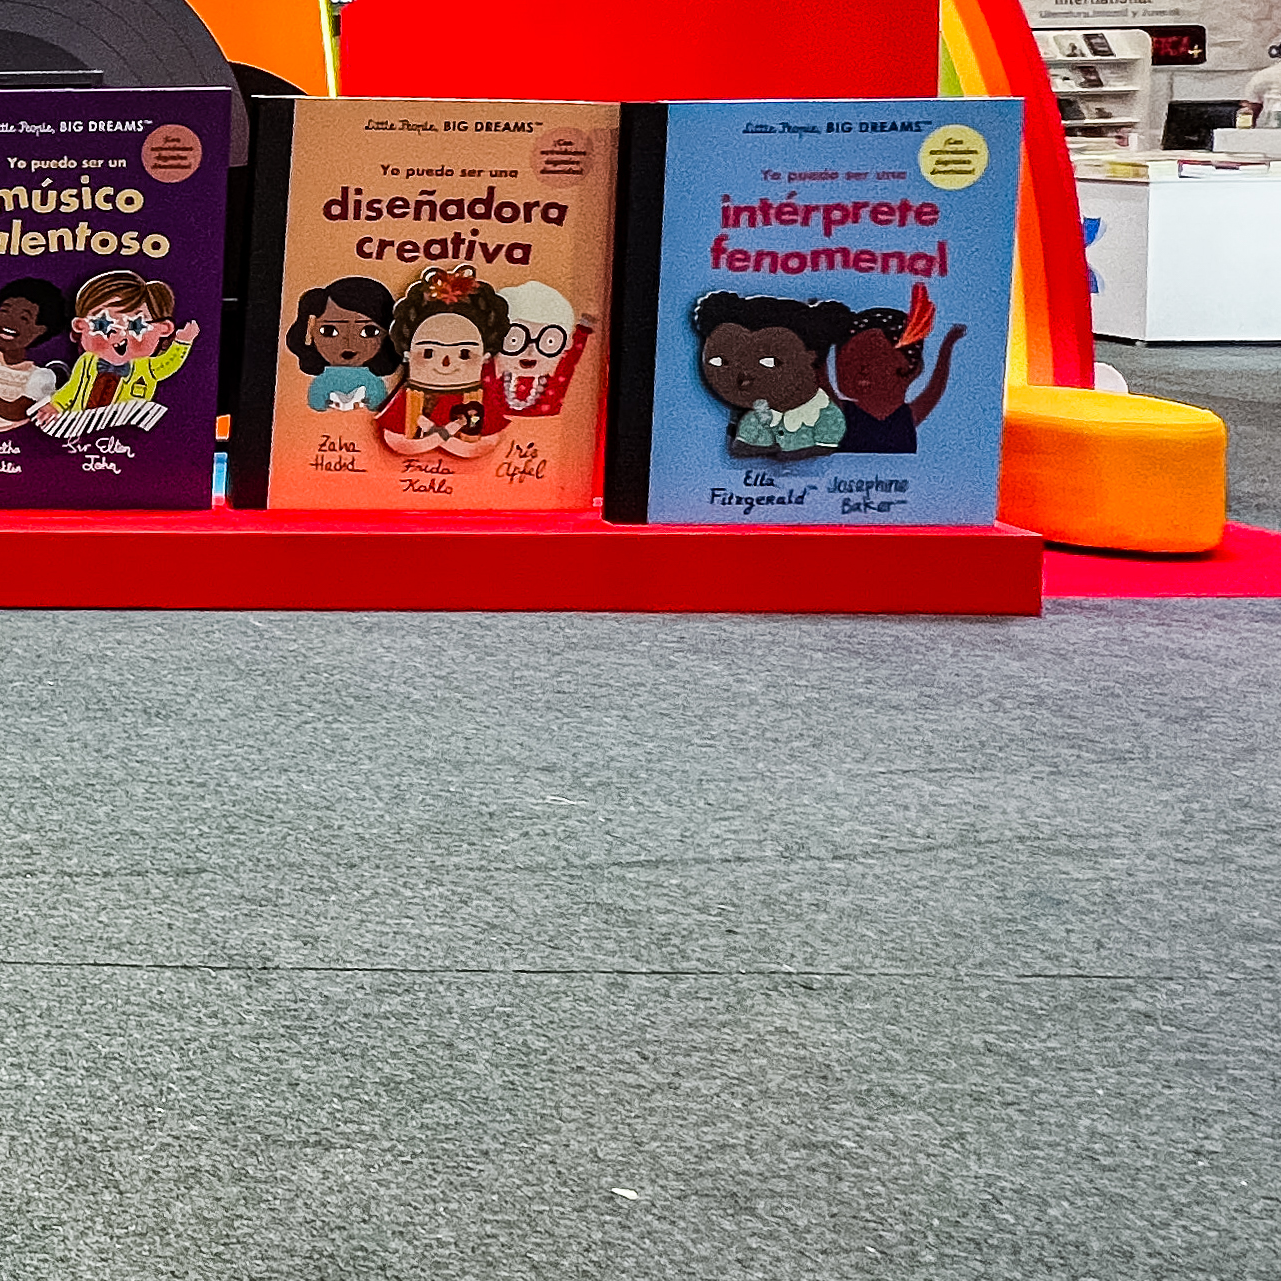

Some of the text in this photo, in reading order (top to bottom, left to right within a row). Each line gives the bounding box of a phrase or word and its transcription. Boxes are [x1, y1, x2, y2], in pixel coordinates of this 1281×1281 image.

[59, 121, 83, 133] BIG
[443, 121, 468, 132] BIG
[826, 121, 853, 133] BIG
[7, 155, 127, 172] Yo puedo ser un
[380, 164, 518, 179] Yo puedo ser una
[761, 169, 782, 181] Yo
[788, 168, 839, 183] puedo
[323, 185, 568, 227] diseñadora
[721, 190, 940, 238] intérprete
[356, 228, 532, 265] creativa
[710, 233, 949, 277] fenomenal
[505, 439, 538, 459] Iris
[401, 458, 455, 475] Frida
[400, 478, 454, 495] Kahlo
[743, 470, 775, 487] Ella
[827, 475, 909, 500] Josephine
[709, 484, 818, 515] Fitzgerald
[841, 497, 908, 515] Baker
